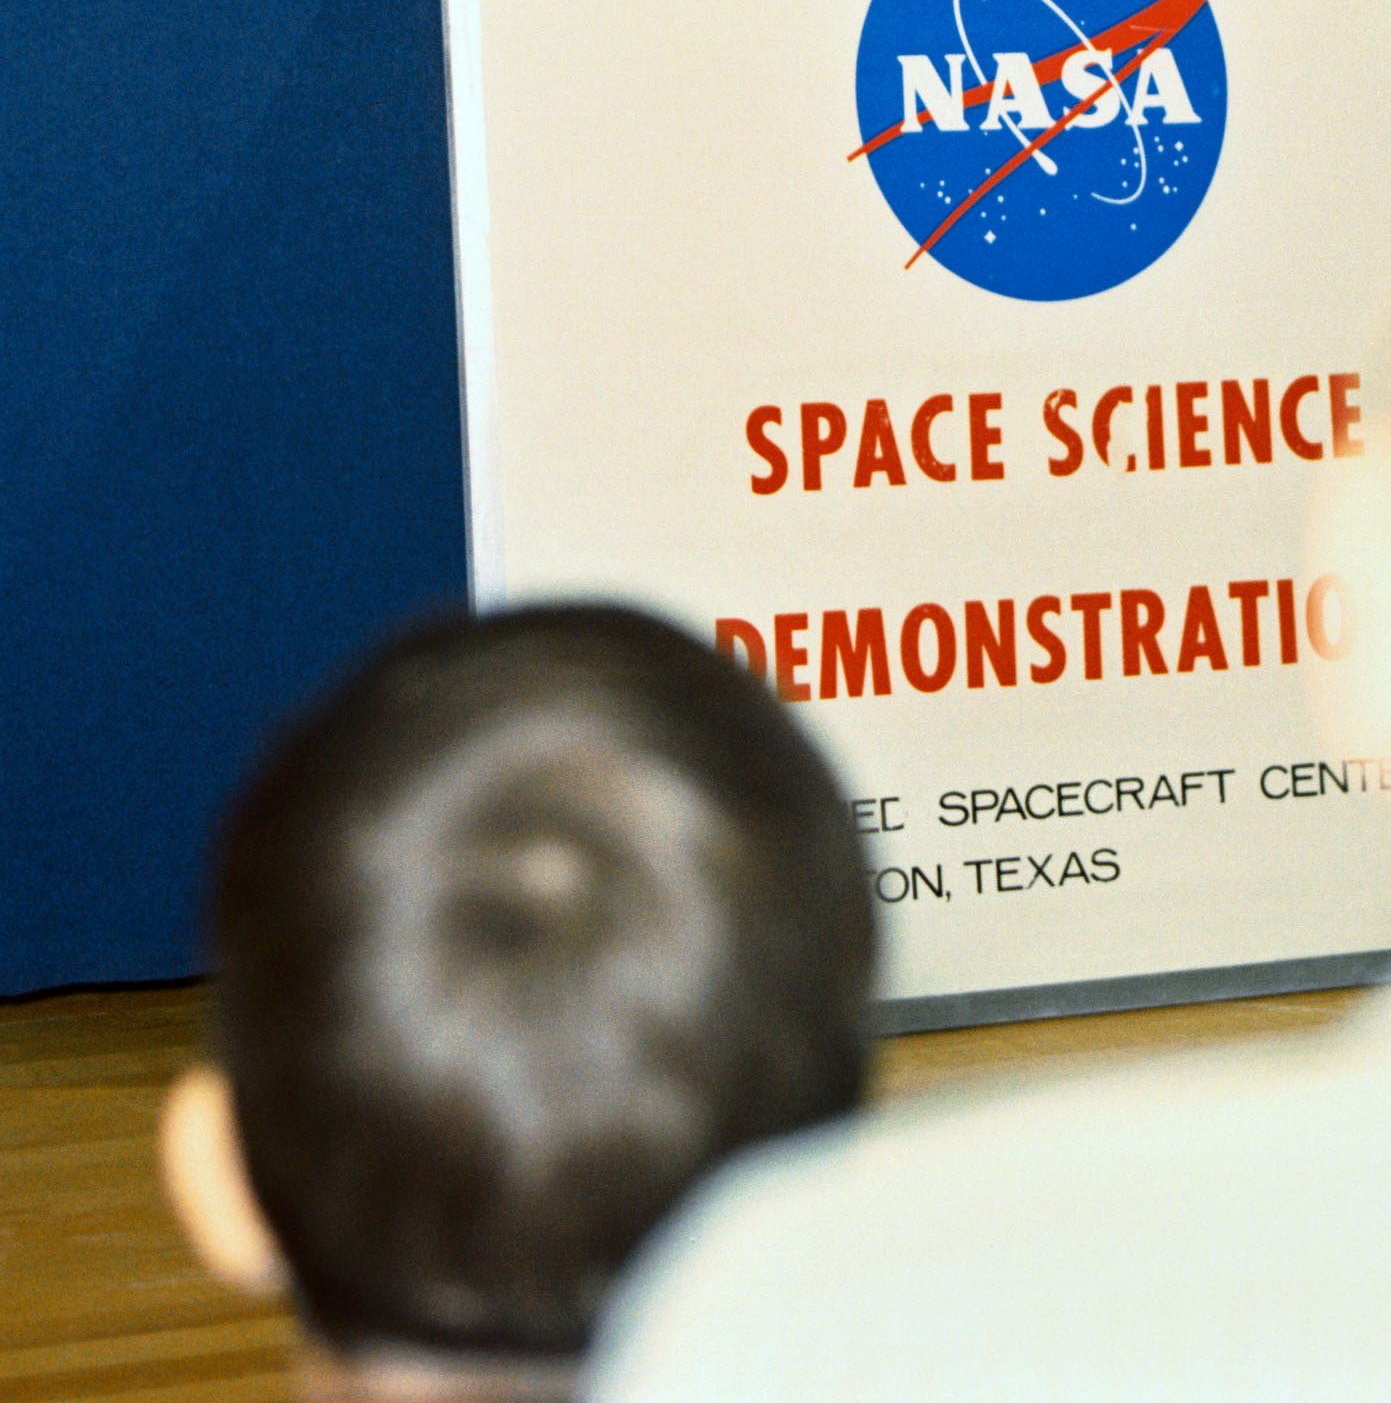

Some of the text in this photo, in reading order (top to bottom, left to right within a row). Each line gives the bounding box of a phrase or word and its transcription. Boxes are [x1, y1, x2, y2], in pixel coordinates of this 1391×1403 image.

[897, 47, 1202, 133] NASA
[745, 372, 1365, 495] SPACE SCIENCE
[714, 574, 1356, 702] DEMONSTRATIO
[939, 768, 1235, 826] SPACECRAFT
[963, 849, 1121, 895] TEXAS
